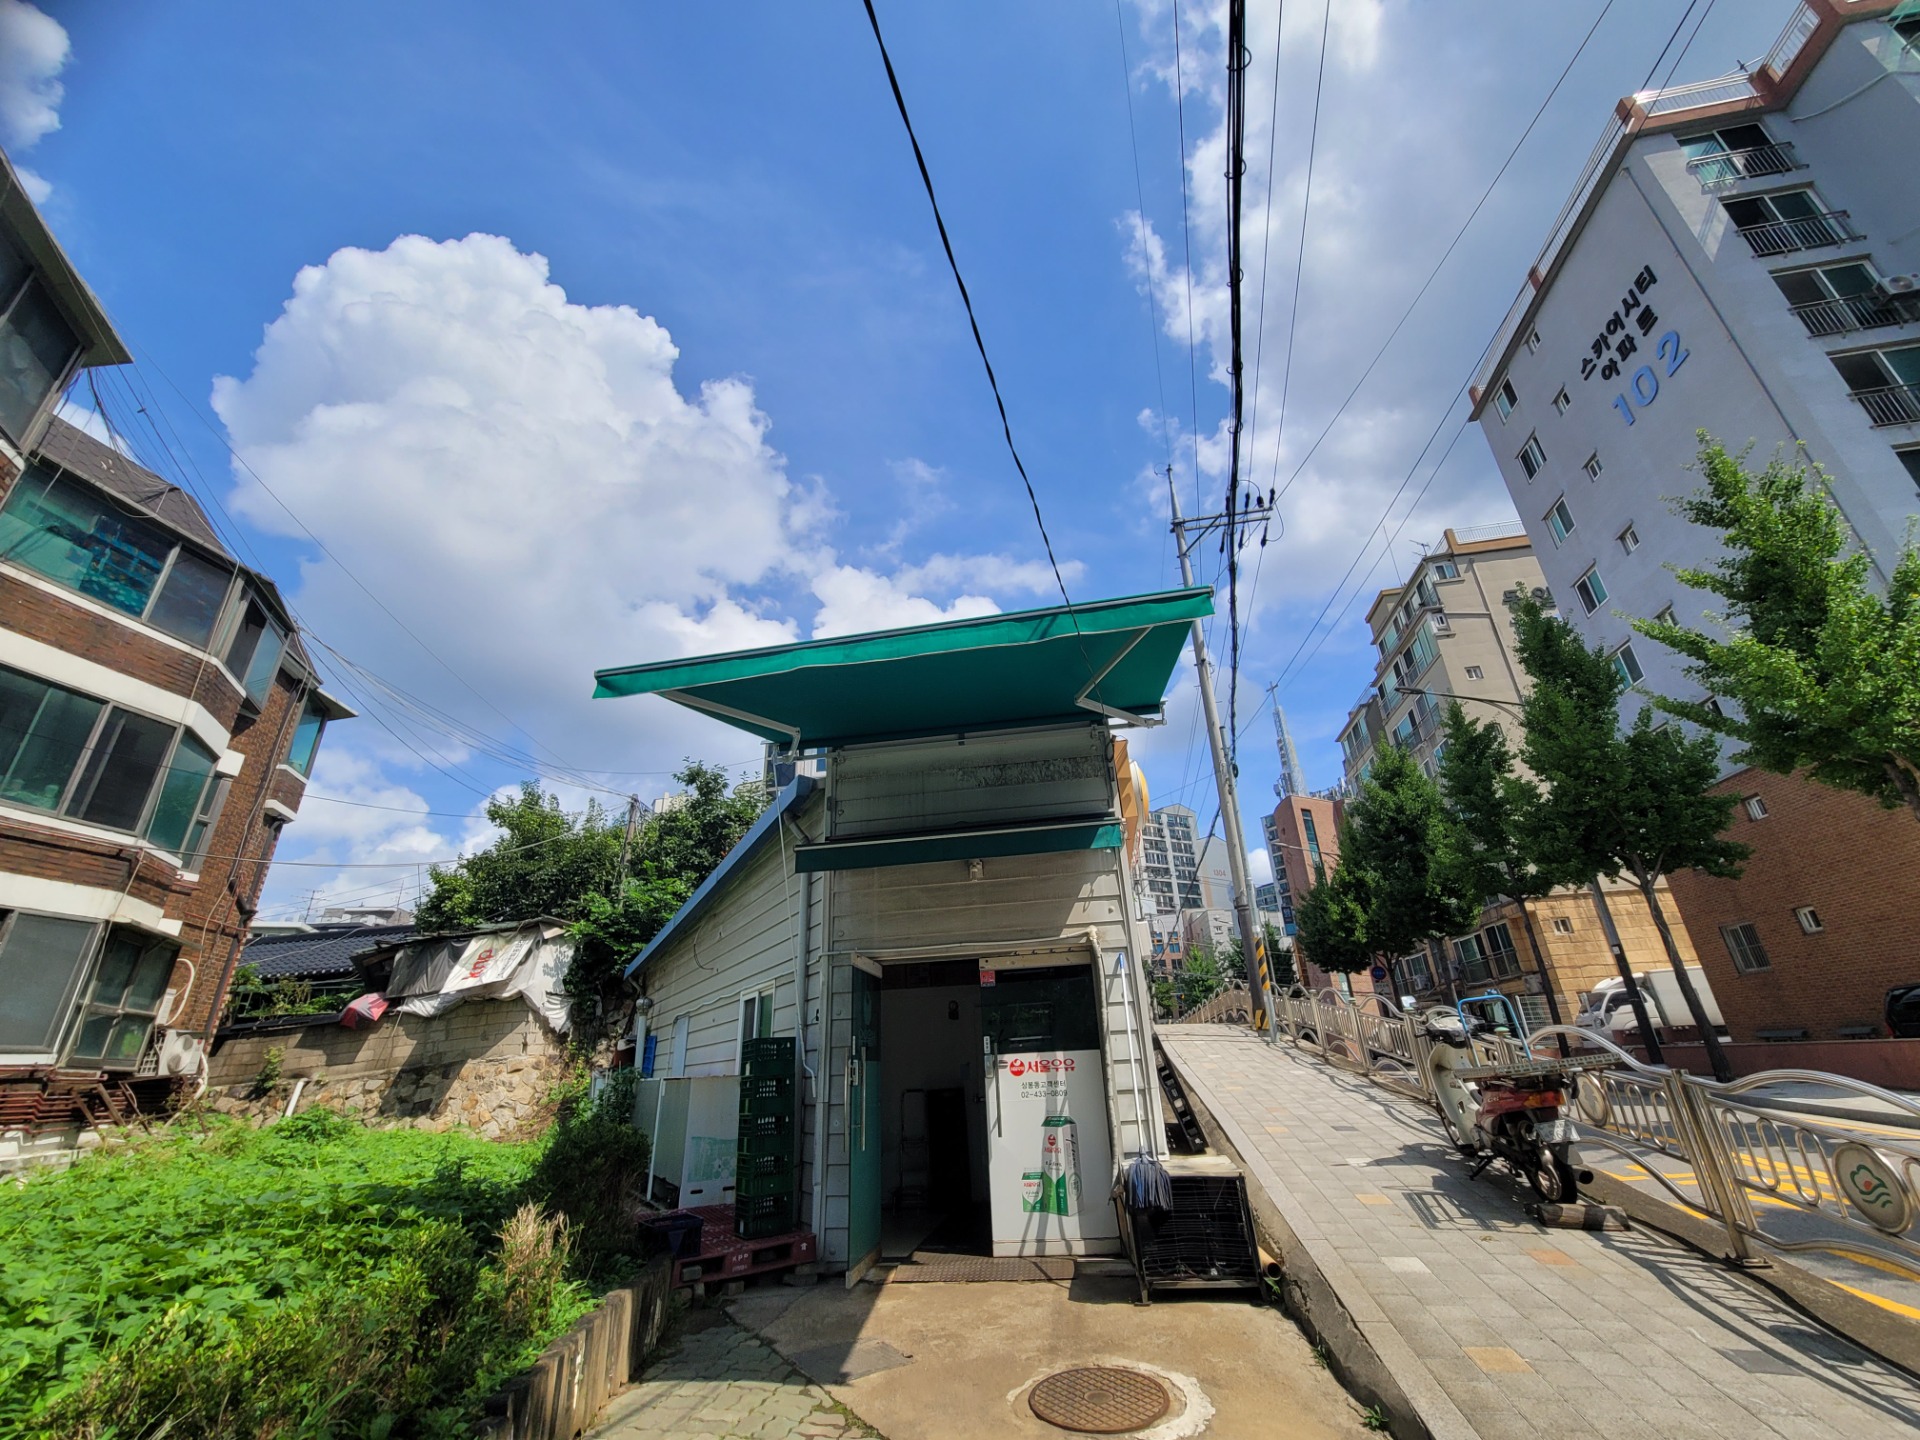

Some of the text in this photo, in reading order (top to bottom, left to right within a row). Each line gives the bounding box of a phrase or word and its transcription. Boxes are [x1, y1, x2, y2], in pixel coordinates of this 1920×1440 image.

[1580, 265, 1658, 381] 스카이시티
[1601, 305, 1659, 381] 아파트
[1612, 330, 1690, 427] 102
[1026, 1058, 1076, 1073] 서울우유
